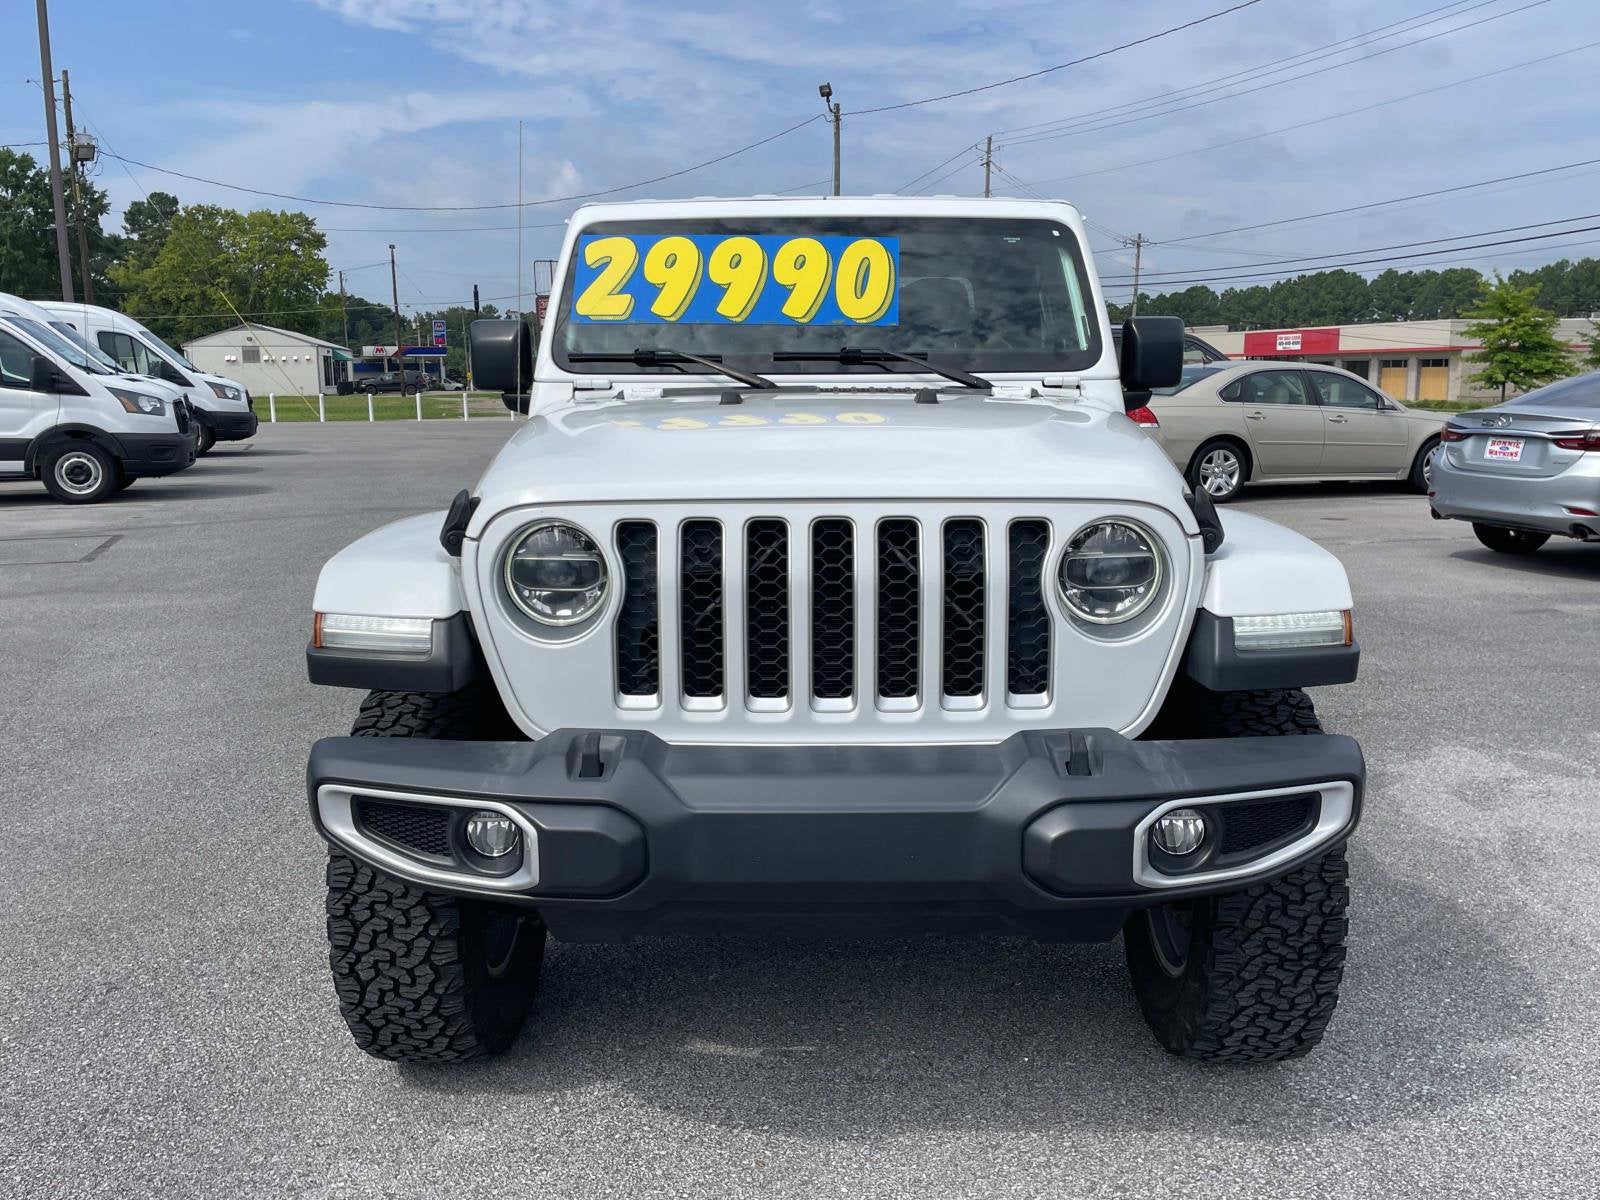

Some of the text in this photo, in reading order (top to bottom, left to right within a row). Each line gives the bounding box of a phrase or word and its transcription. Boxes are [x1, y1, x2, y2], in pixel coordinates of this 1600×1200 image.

[575, 236, 895, 323] 29990
[1490, 440, 1521, 449] RONNIE
[1488, 449, 1519, 458] WATKINS
